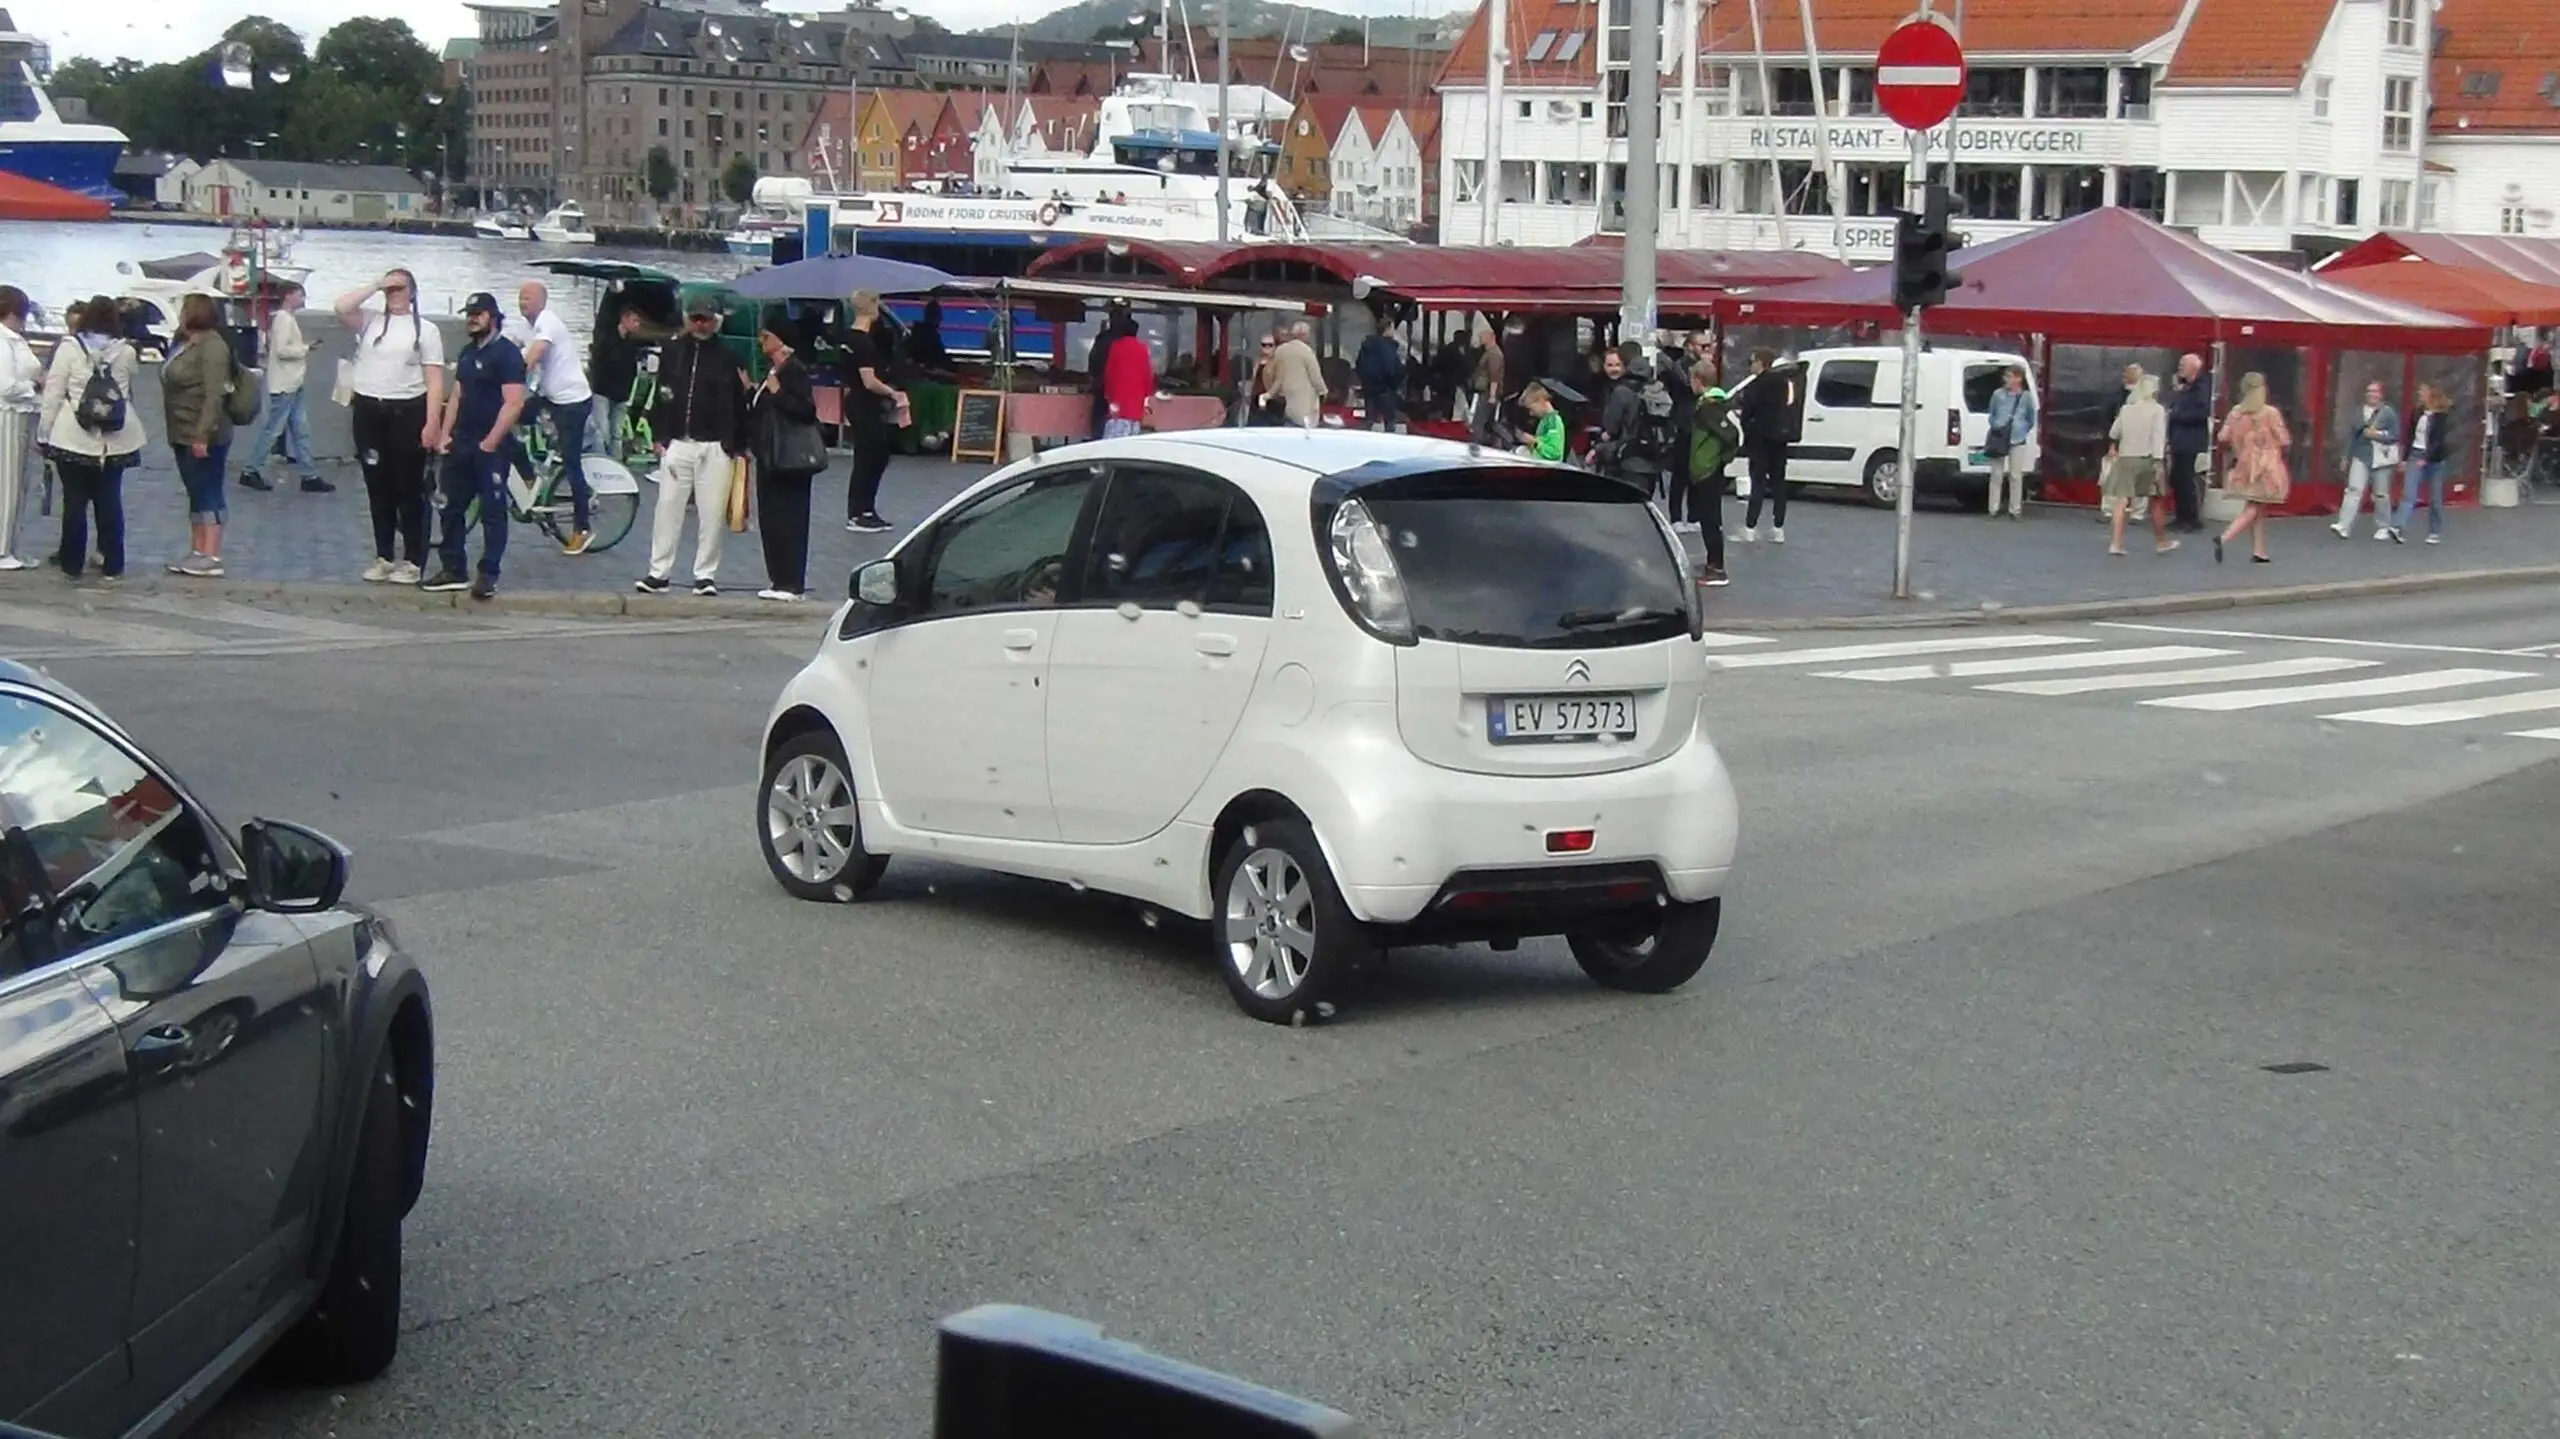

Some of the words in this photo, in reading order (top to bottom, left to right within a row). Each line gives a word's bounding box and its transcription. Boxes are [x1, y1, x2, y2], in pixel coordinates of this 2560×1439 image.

[948, 207, 985, 220] FJORD
[1514, 703, 1543, 731] EV
[1556, 701, 1626, 730] 57373
